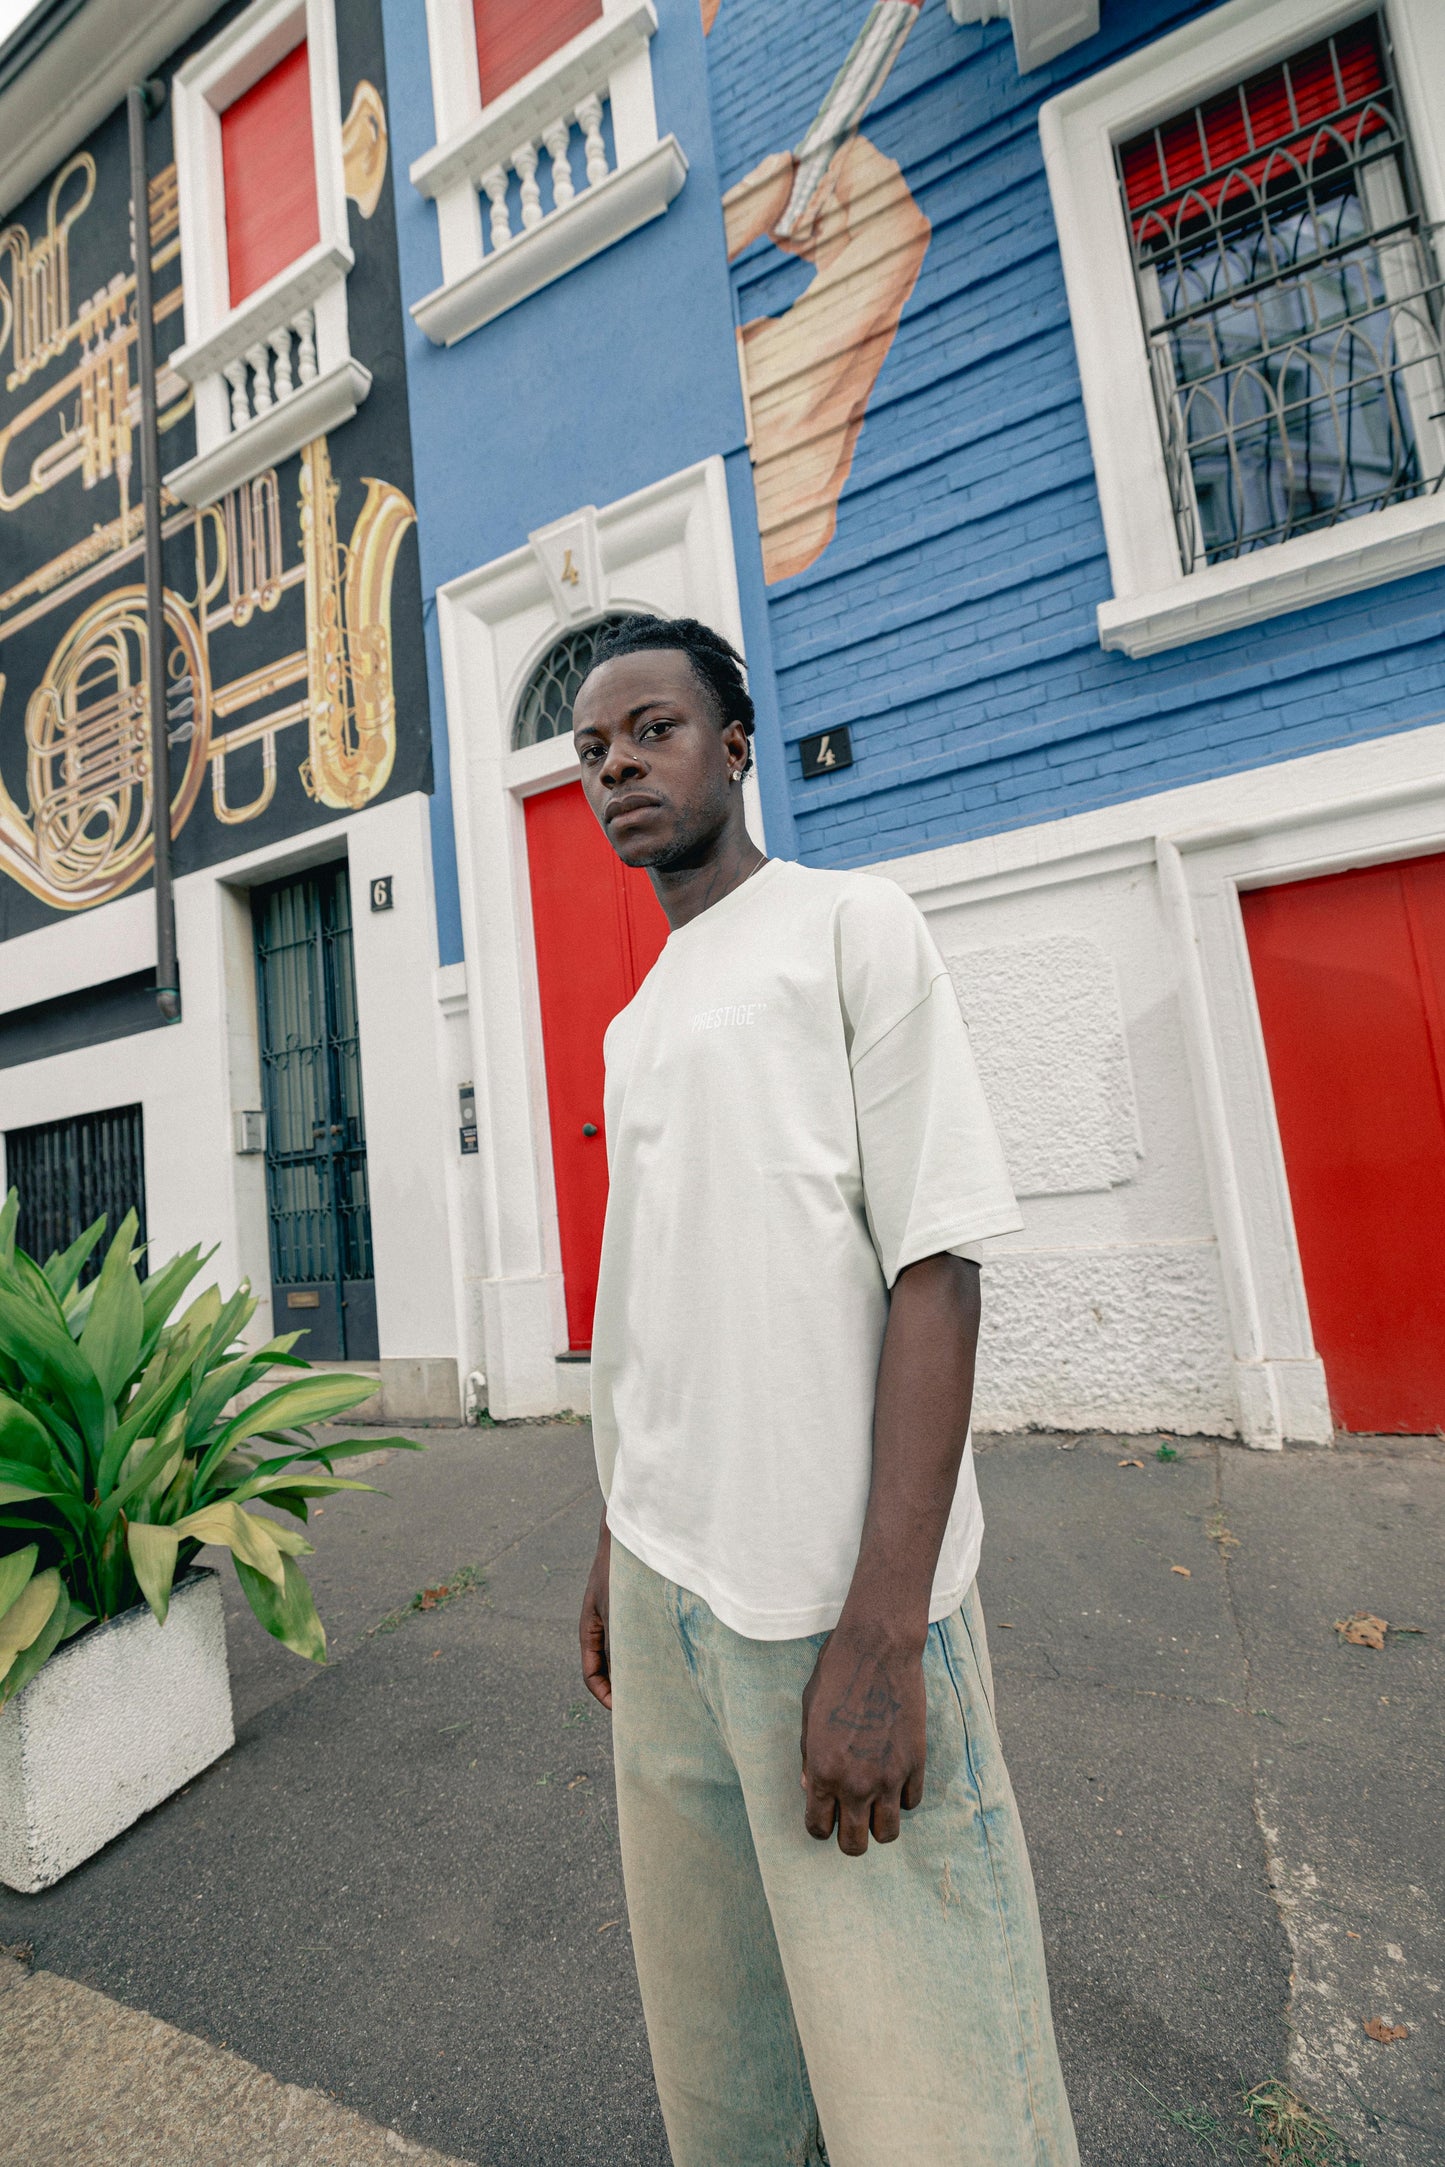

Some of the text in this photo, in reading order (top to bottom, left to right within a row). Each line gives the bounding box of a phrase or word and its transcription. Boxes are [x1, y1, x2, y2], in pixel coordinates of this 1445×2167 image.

[561, 549, 579, 586] 4
[816, 735, 836, 767] 4
[374, 880, 387, 906] 6
